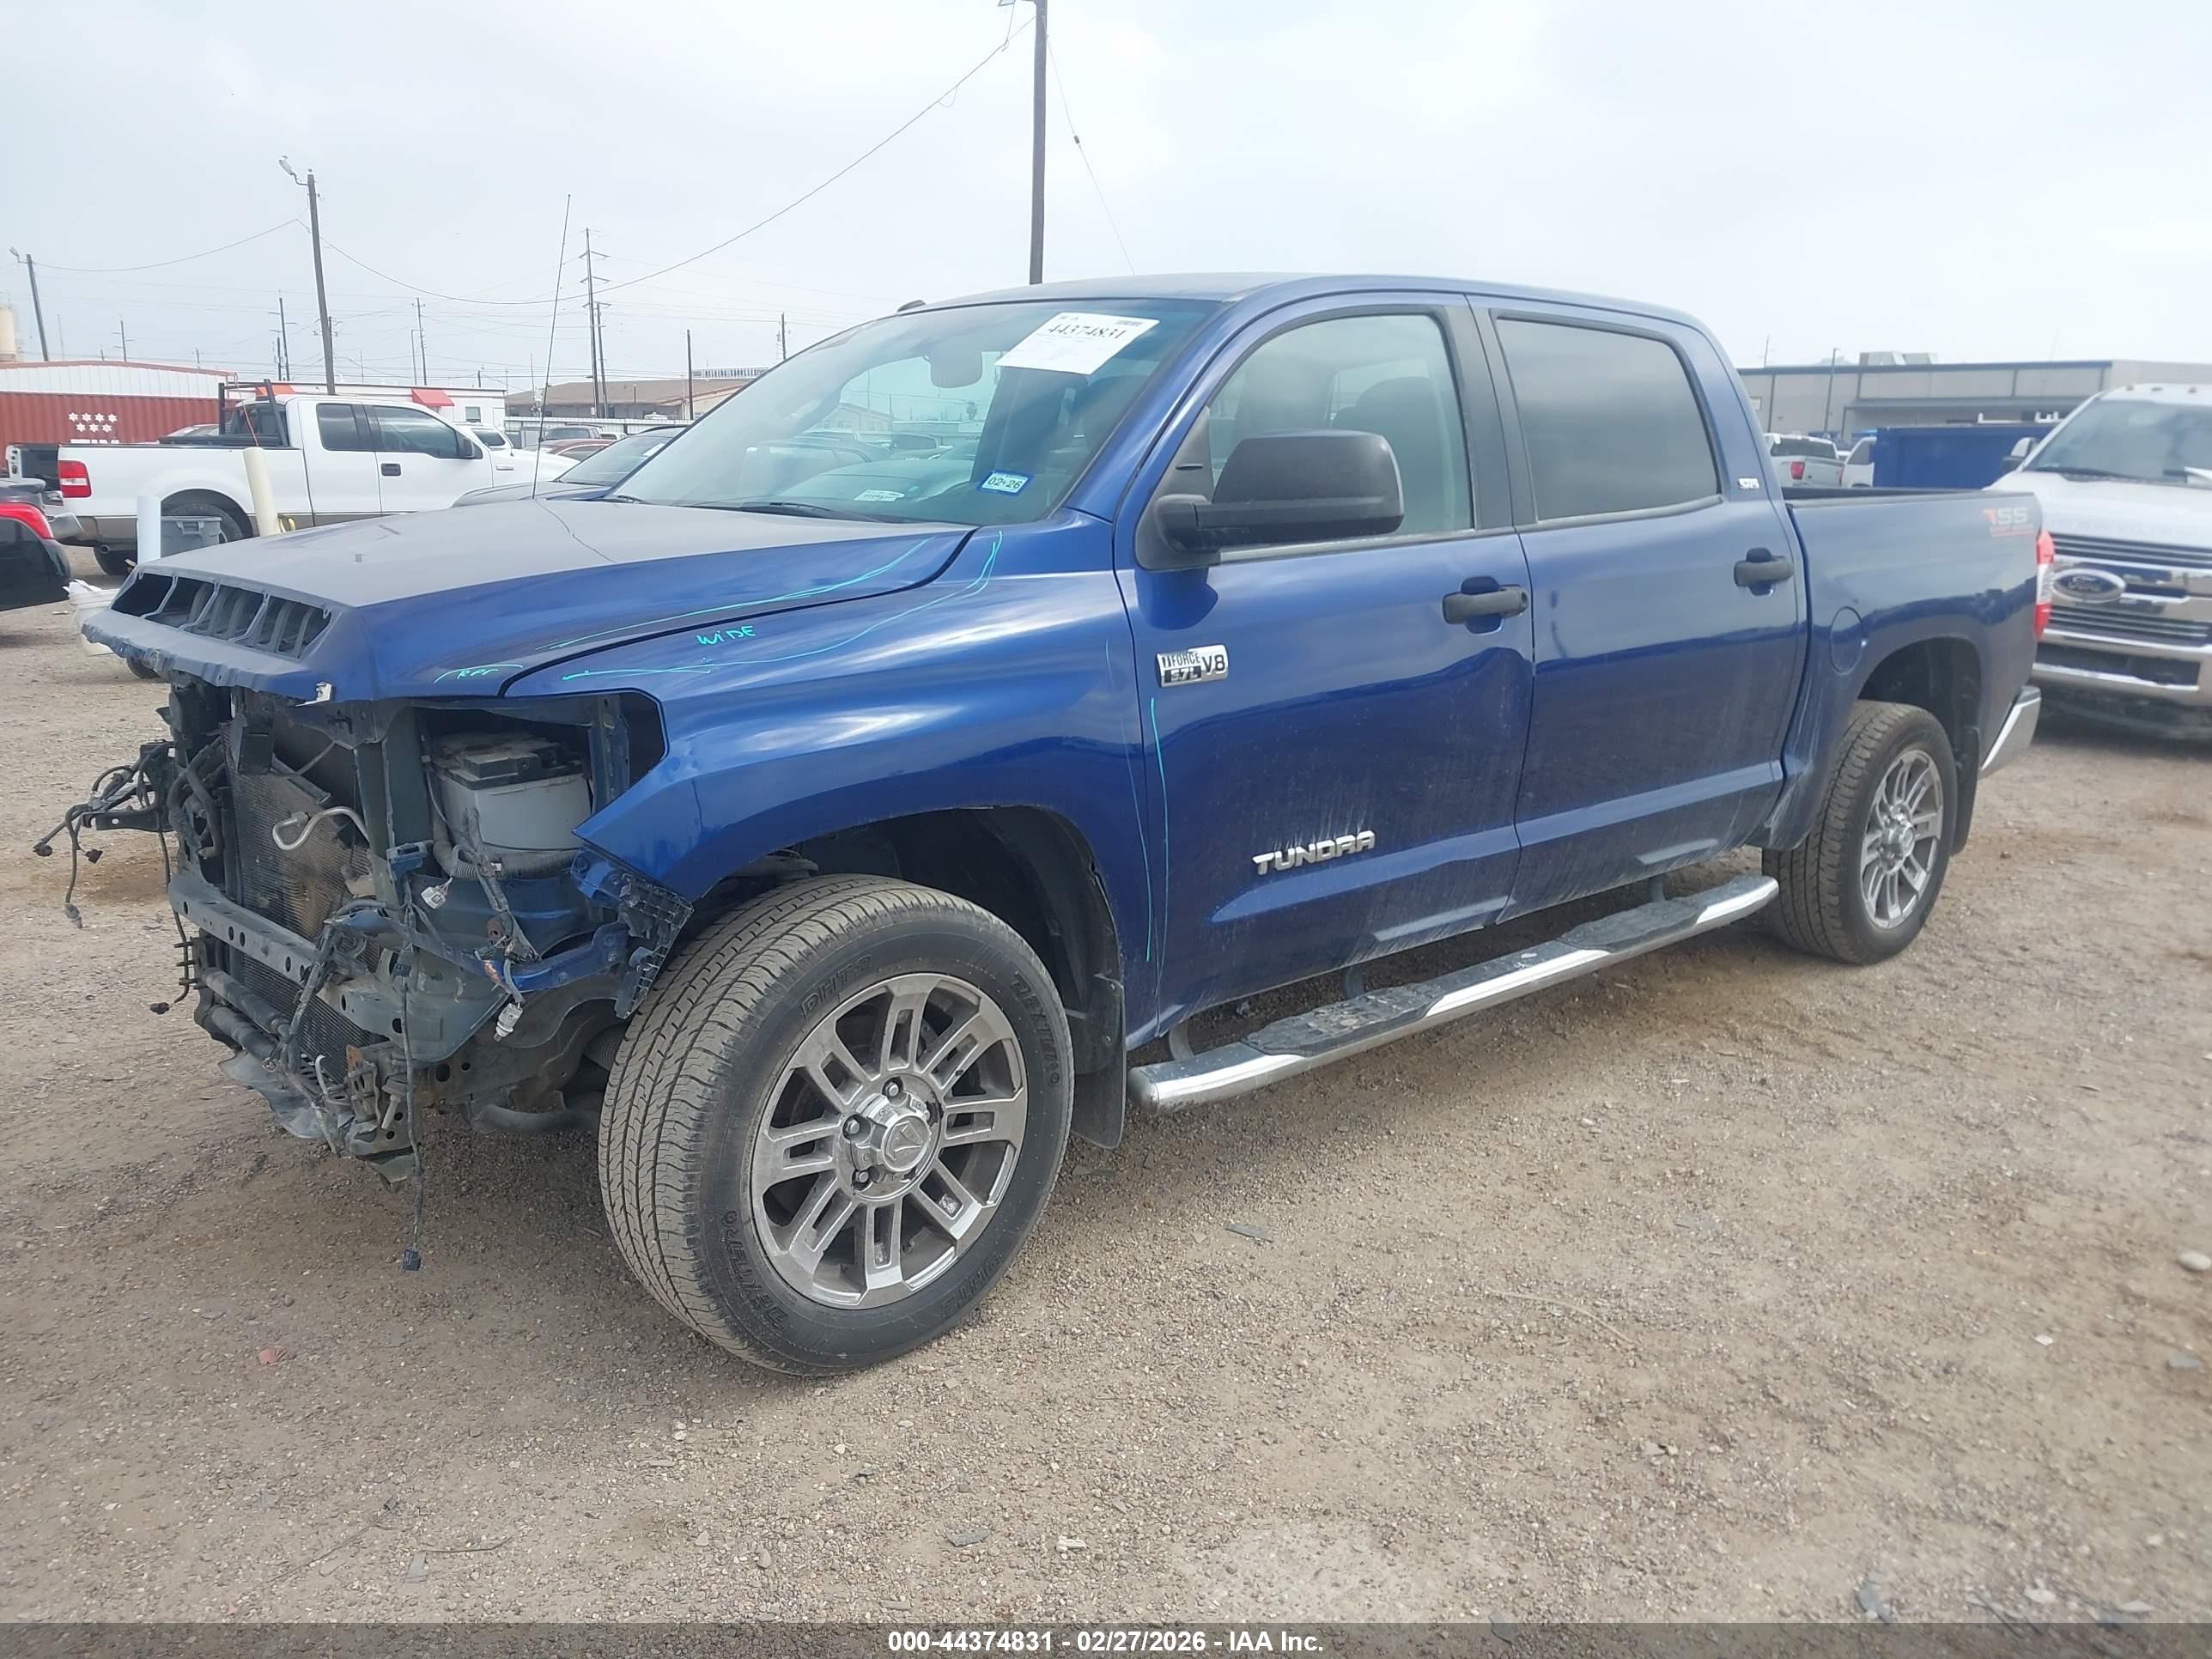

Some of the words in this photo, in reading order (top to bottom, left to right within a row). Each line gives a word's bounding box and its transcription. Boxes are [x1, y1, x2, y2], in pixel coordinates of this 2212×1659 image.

[1047, 322, 1127, 339] 44374831
[1202, 654, 1225, 673] V8
[1252, 830, 1375, 875] TUNDRA
